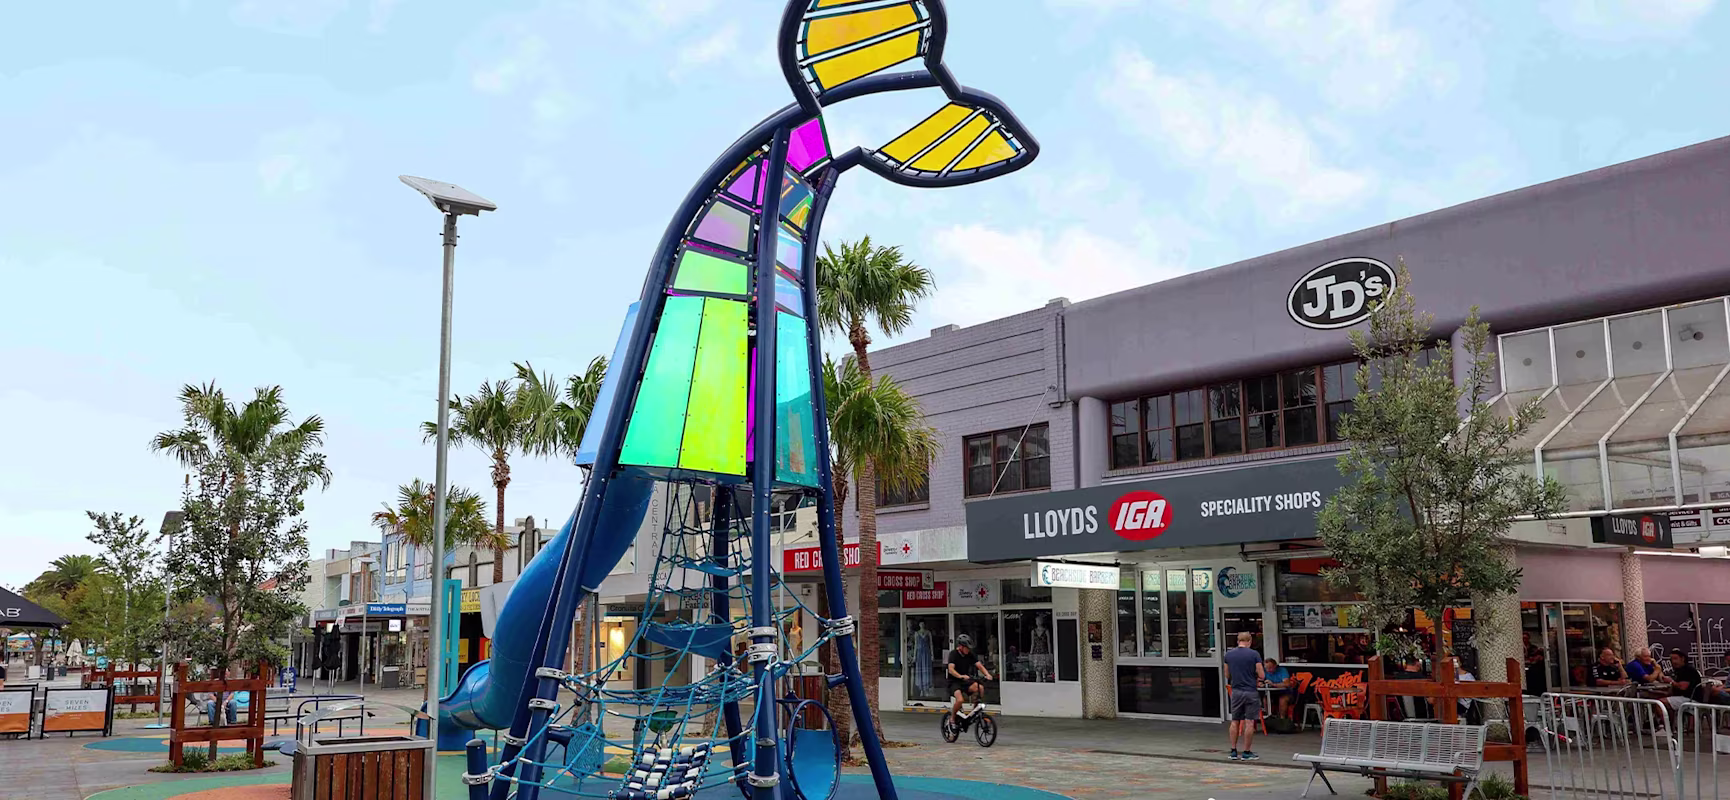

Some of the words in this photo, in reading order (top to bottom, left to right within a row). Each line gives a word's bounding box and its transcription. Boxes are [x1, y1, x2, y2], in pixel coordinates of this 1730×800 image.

[1303, 270, 1383, 319] JD's
[1200, 495, 1272, 518] SPECIALITY
[1275, 490, 1322, 511] SHOPS
[651, 500, 659, 558] CENTRAL
[1023, 505, 1098, 540] LLOYDS
[1611, 517, 1638, 536] LLOYDS
[1642, 520, 1655, 537] IGA
[795, 552, 809, 569] RED
[843, 547, 860, 566] SHO
[884, 575, 904, 587] CROSS
[905, 575, 920, 588] SHOP
[1051, 567, 1087, 583] BEACHSIDE
[1228, 579, 1256, 590] BARBERS
[907, 591, 915, 600] RED
[916, 590, 931, 600] CROSS
[932, 590, 945, 599] SHOP
